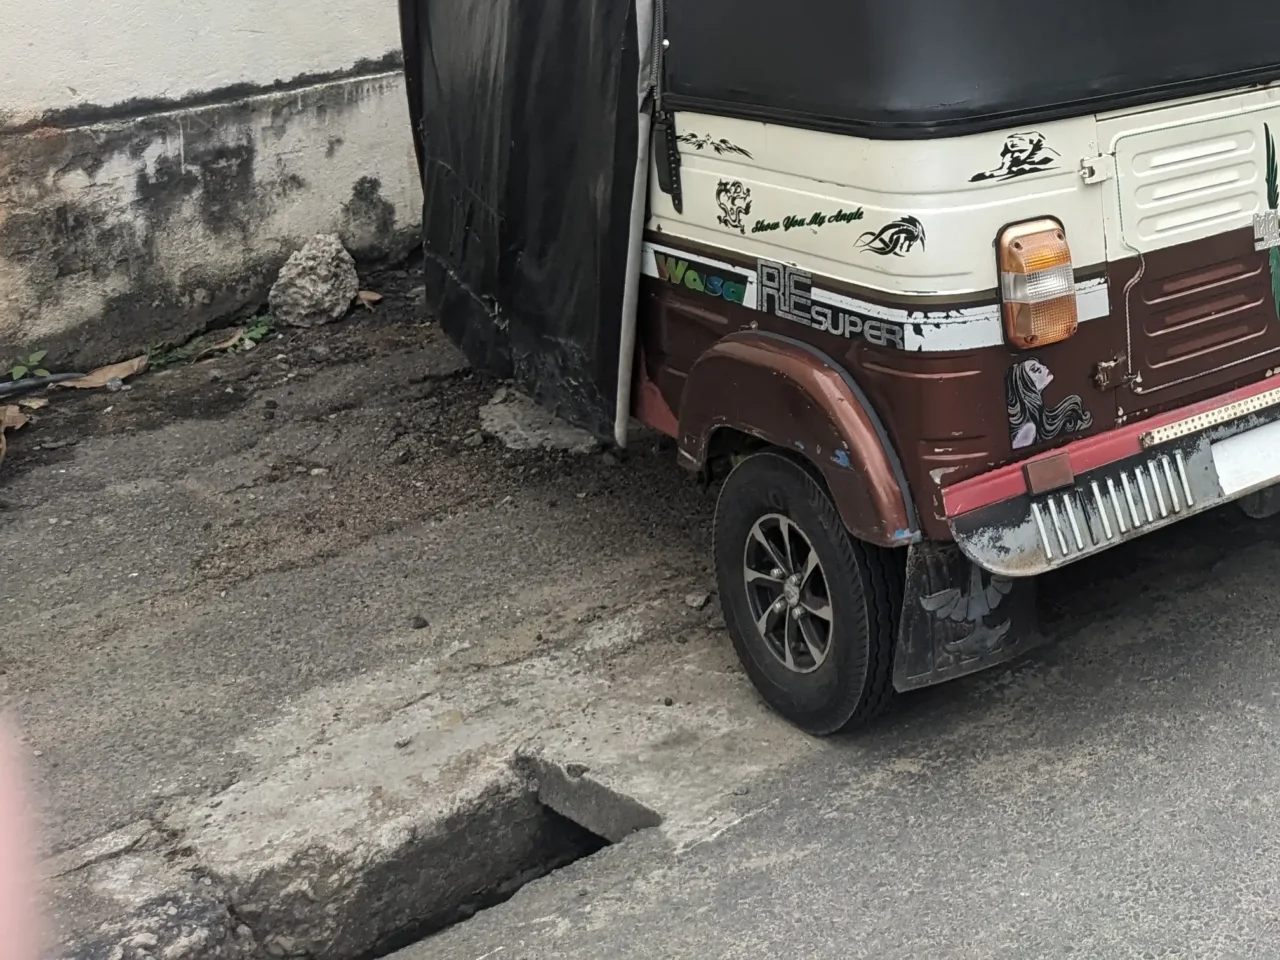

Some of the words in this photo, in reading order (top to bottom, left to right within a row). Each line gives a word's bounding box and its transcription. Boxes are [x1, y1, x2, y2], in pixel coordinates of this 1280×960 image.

[751, 219, 780, 234] Show
[783, 215, 807, 232] You
[806, 211, 828, 227] My
[827, 206, 865, 224] Angle
[655, 253, 747, 305] Wasa
[756, 258, 812, 327] RE
[810, 305, 905, 350] SUPER
